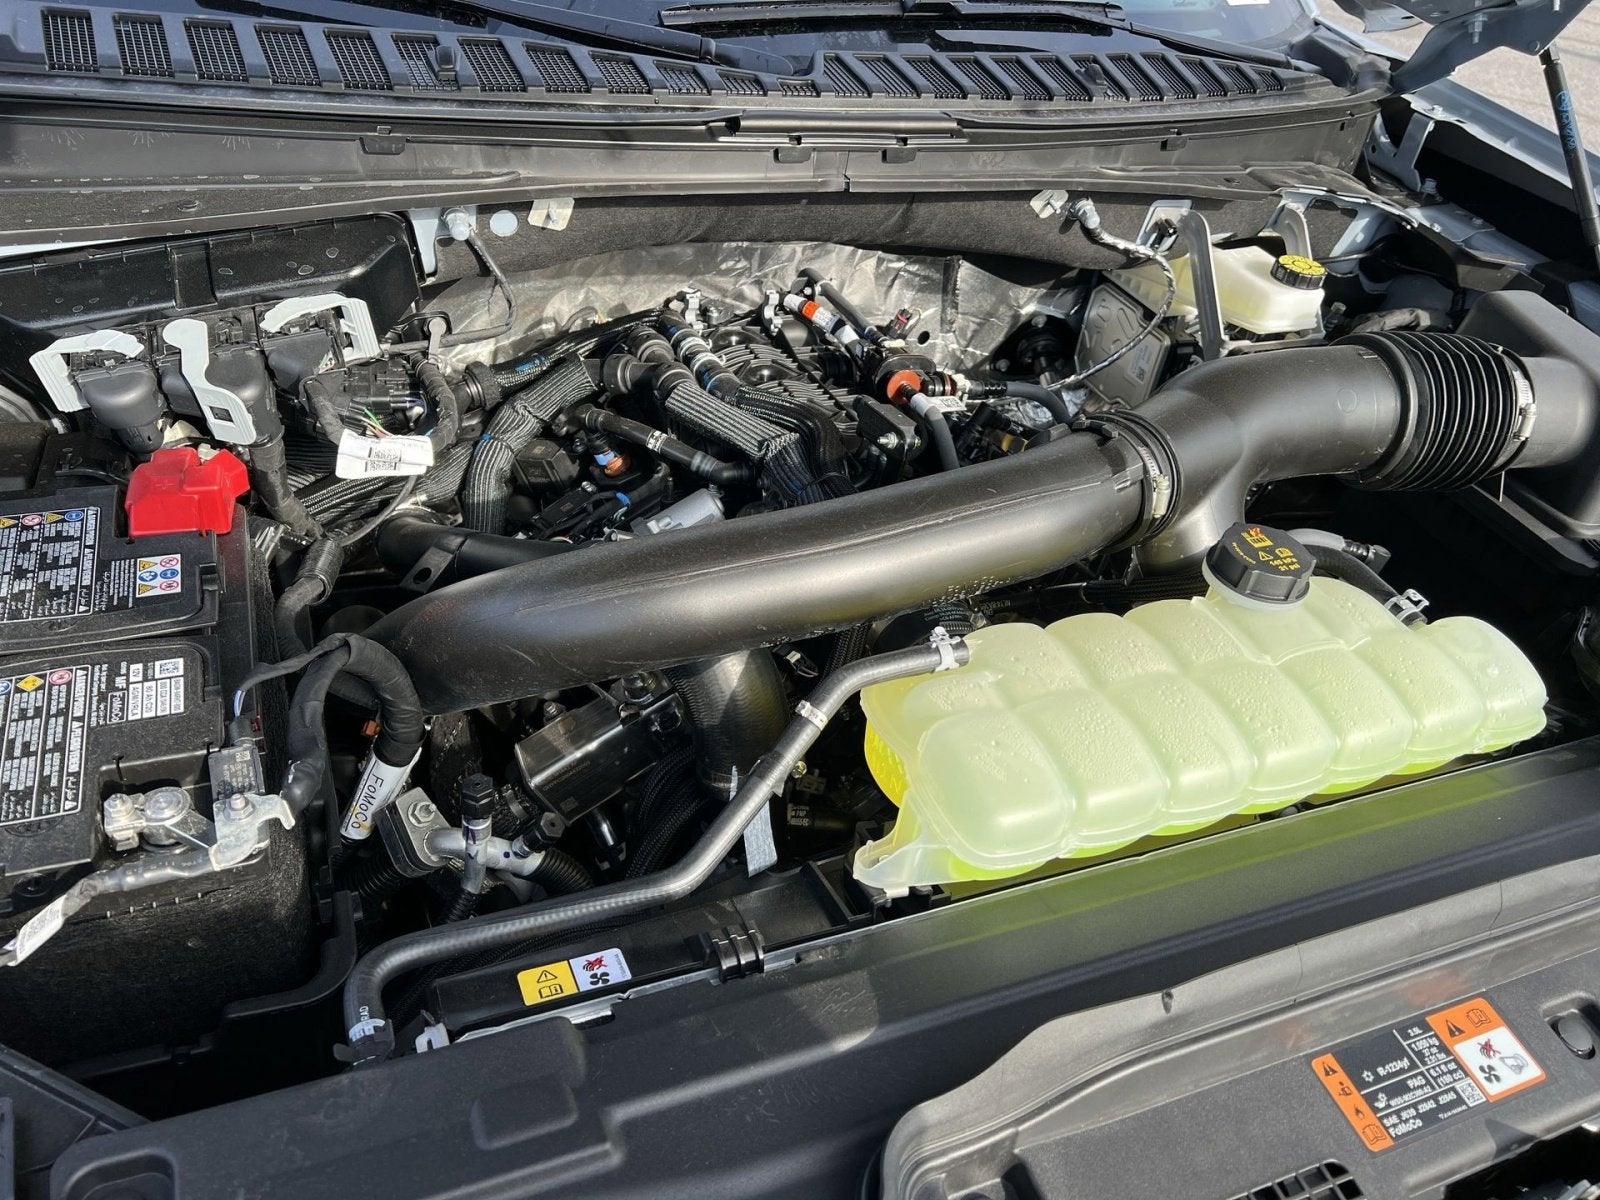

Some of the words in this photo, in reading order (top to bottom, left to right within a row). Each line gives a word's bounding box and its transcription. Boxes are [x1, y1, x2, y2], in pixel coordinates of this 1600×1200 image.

[132, 668, 140, 677] 12V
[115, 676, 126, 689] MF
[111, 692, 123, 722] FoMoCo
[351, 773, 385, 829] FoMoCo
[360, 1006, 370, 1021] RAD
[1427, 1037, 1440, 1046] kg
[1376, 1056, 1410, 1077] R-1234yf
[1406, 1075, 1426, 1089] PAG
[1383, 1114, 1400, 1127] SAE
[1388, 1118, 1423, 1138] FoMoCo
